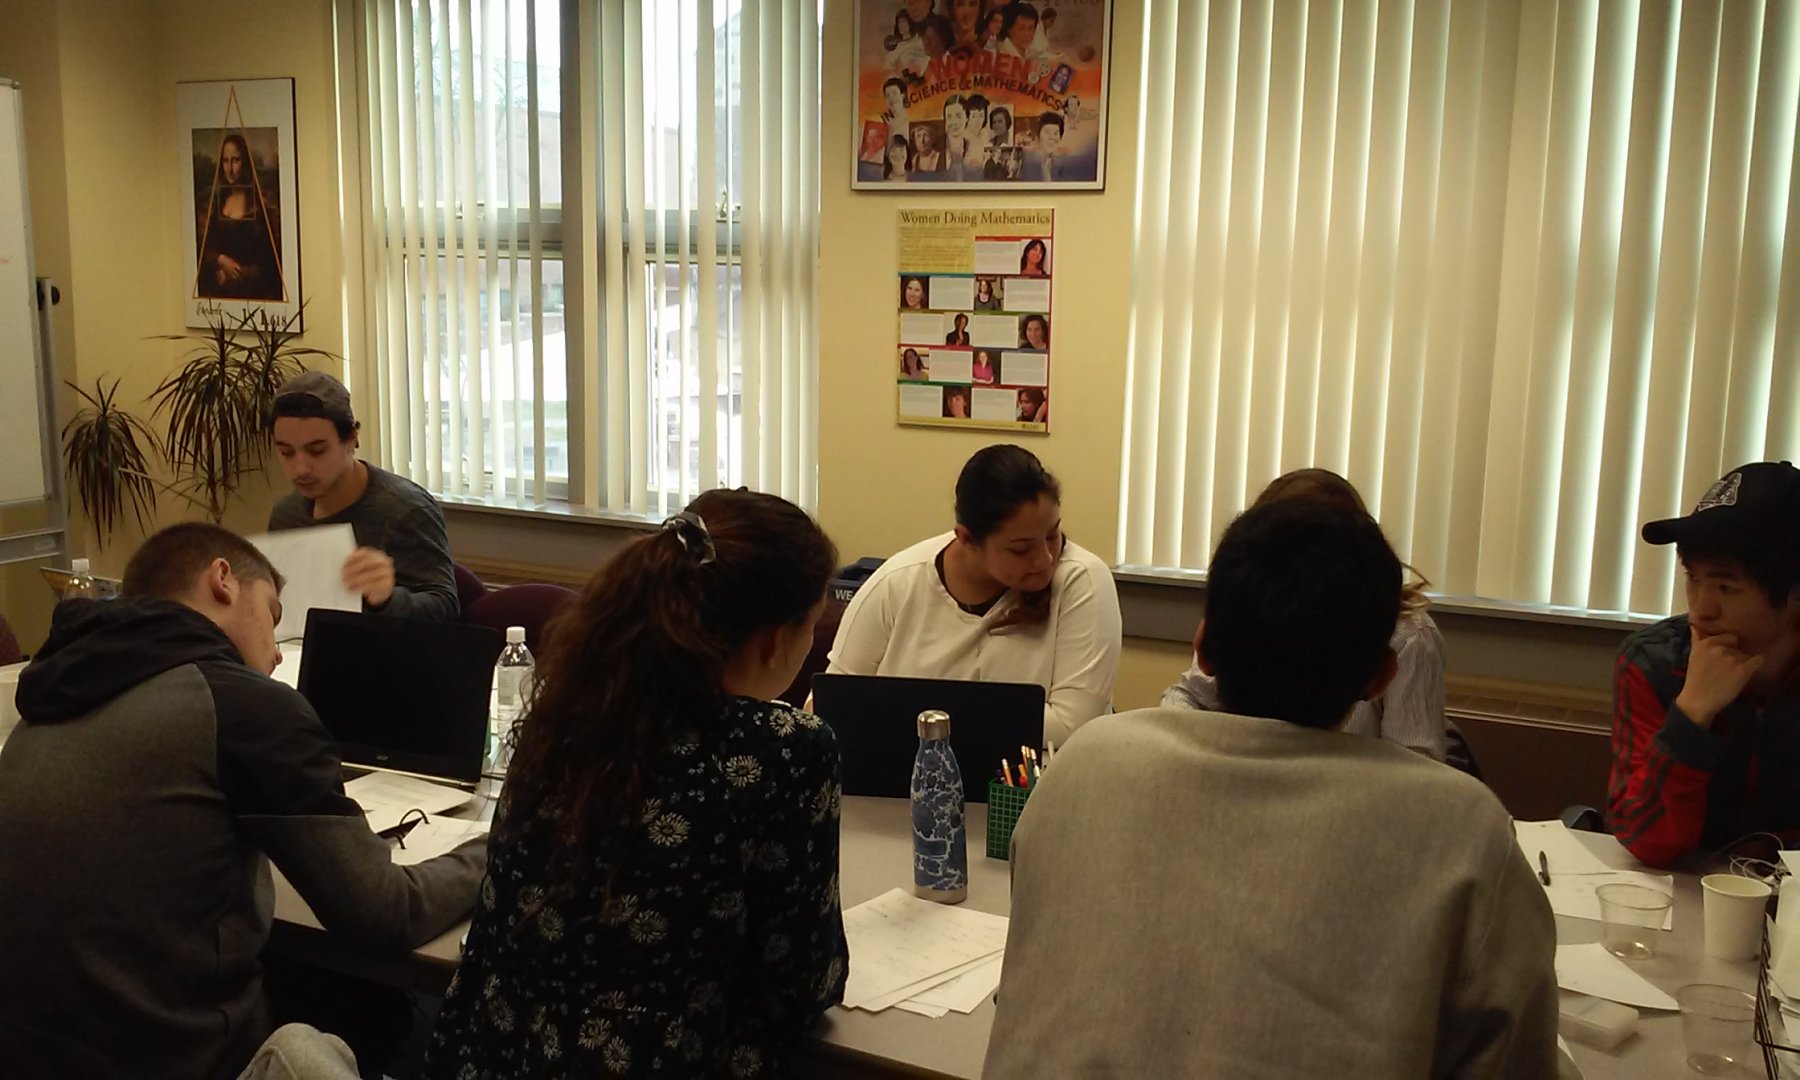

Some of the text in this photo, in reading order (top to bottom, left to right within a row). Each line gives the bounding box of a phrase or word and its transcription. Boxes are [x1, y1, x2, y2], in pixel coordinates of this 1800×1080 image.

[929, 51, 1031, 80] WOMEN
[881, 75, 1062, 124] IN SCIENCE & MATHEMATICS
[901, 211, 1050, 227] Women Doing Mathematics
[835, 589, 853, 600] WE
